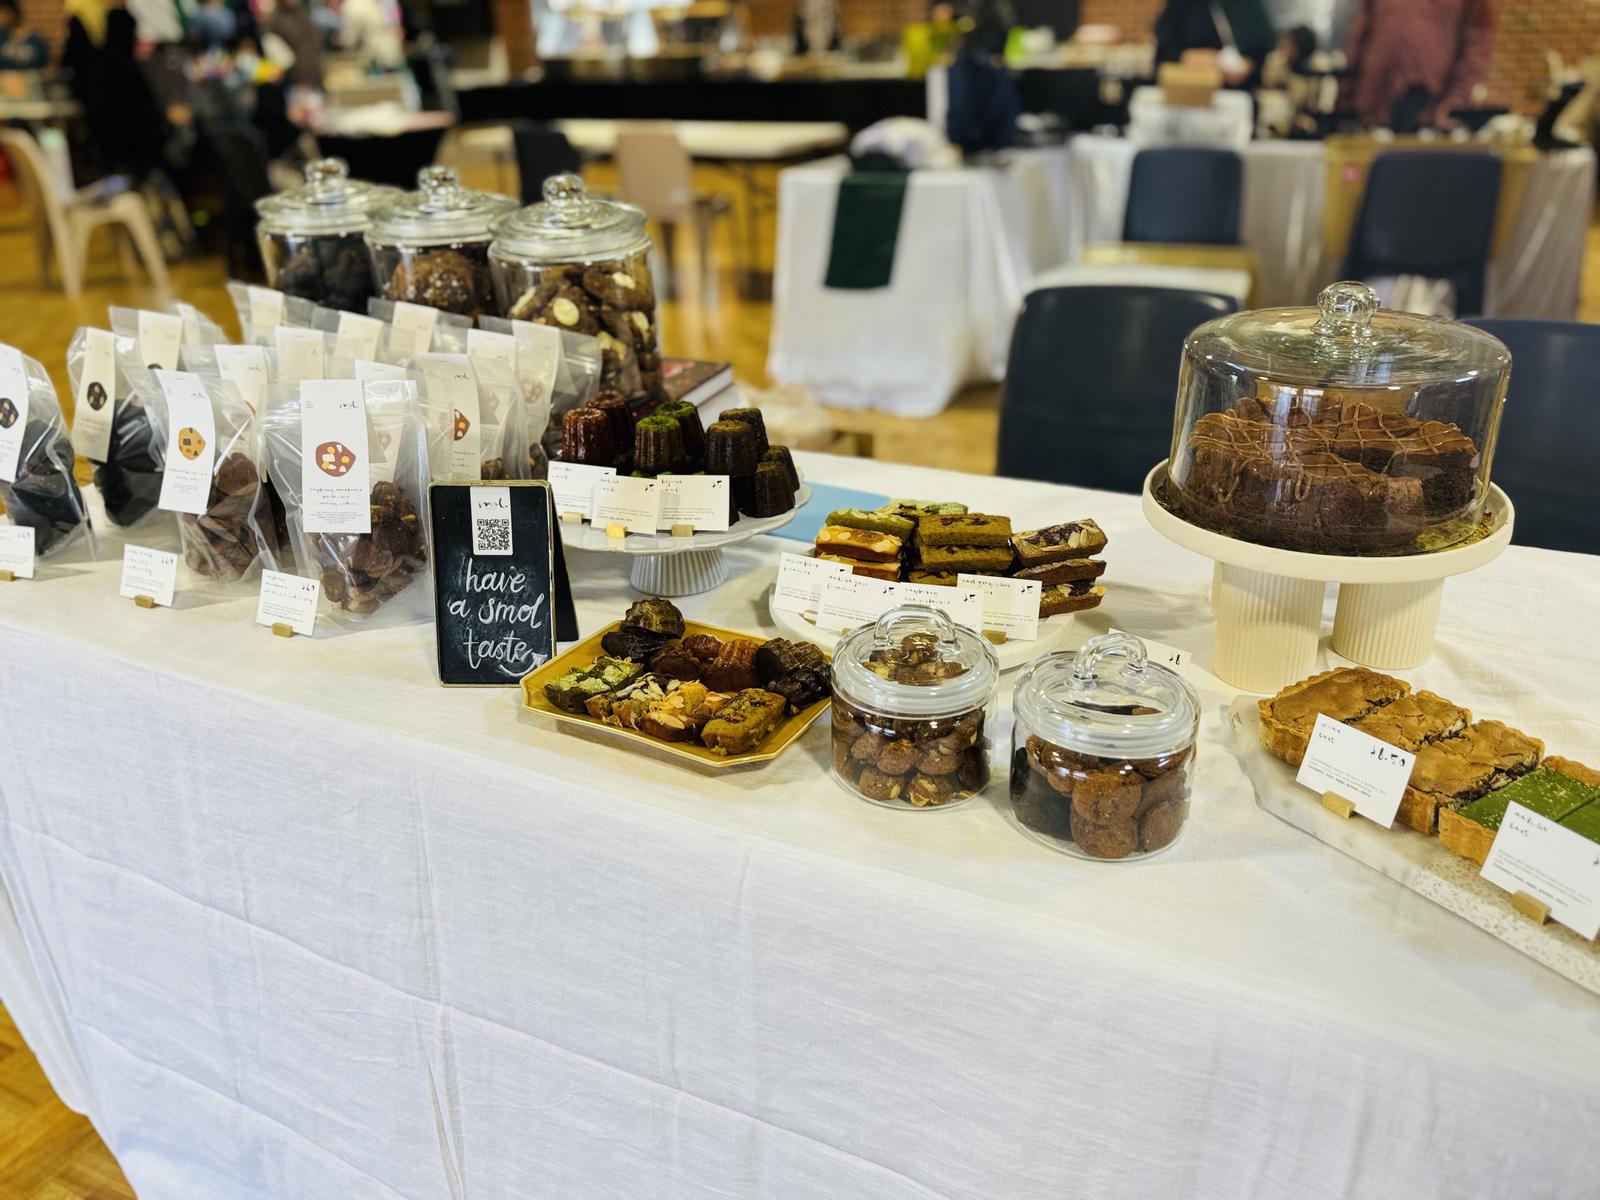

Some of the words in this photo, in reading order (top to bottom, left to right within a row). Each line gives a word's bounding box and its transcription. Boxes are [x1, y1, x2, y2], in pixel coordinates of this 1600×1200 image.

[466, 557, 526, 593] have
[448, 598, 471, 619] a
[478, 592, 545, 628] smol
[462, 626, 533, 670] taste
